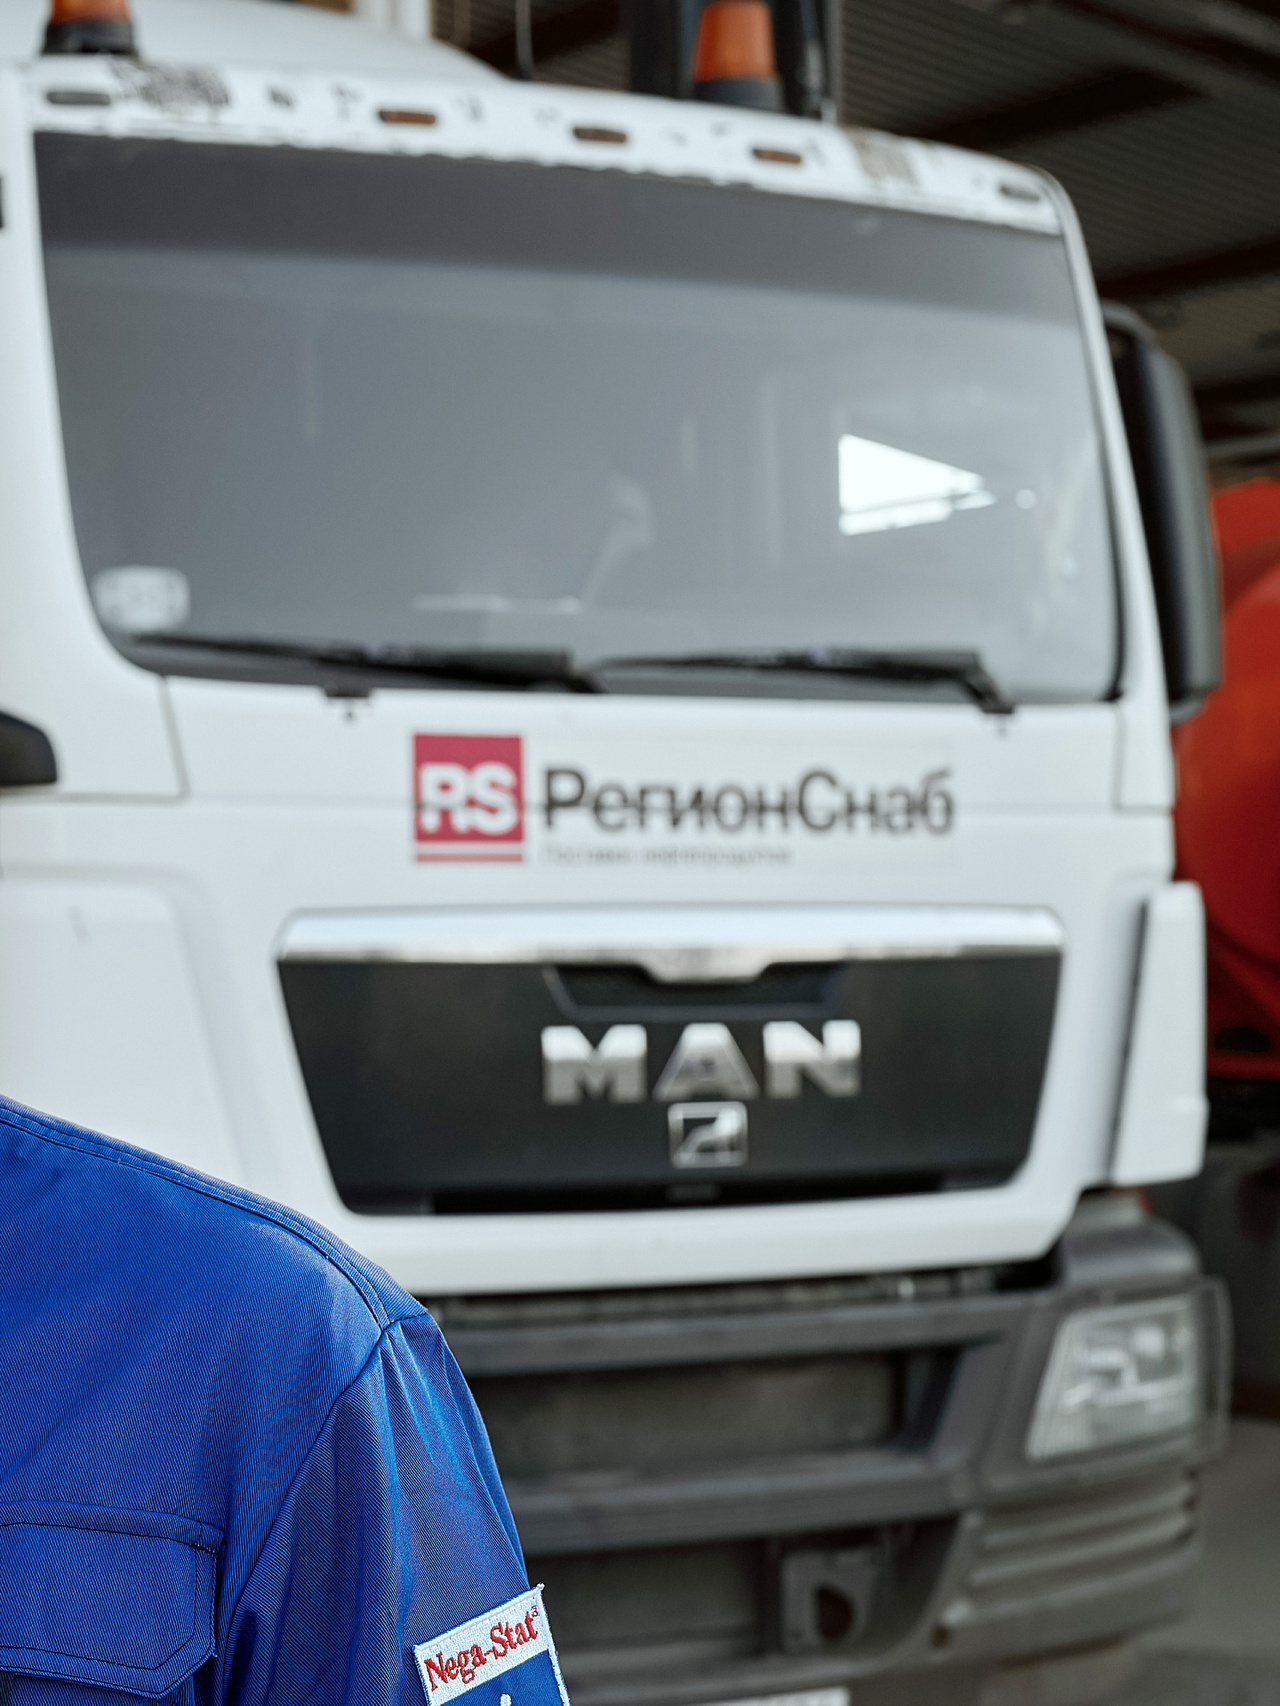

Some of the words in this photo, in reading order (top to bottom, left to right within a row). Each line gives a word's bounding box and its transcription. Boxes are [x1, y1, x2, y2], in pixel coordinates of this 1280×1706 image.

[420, 762, 518, 834] RS
[544, 768, 955, 836] РегионСнаб
[540, 1019, 862, 1105] MAN
